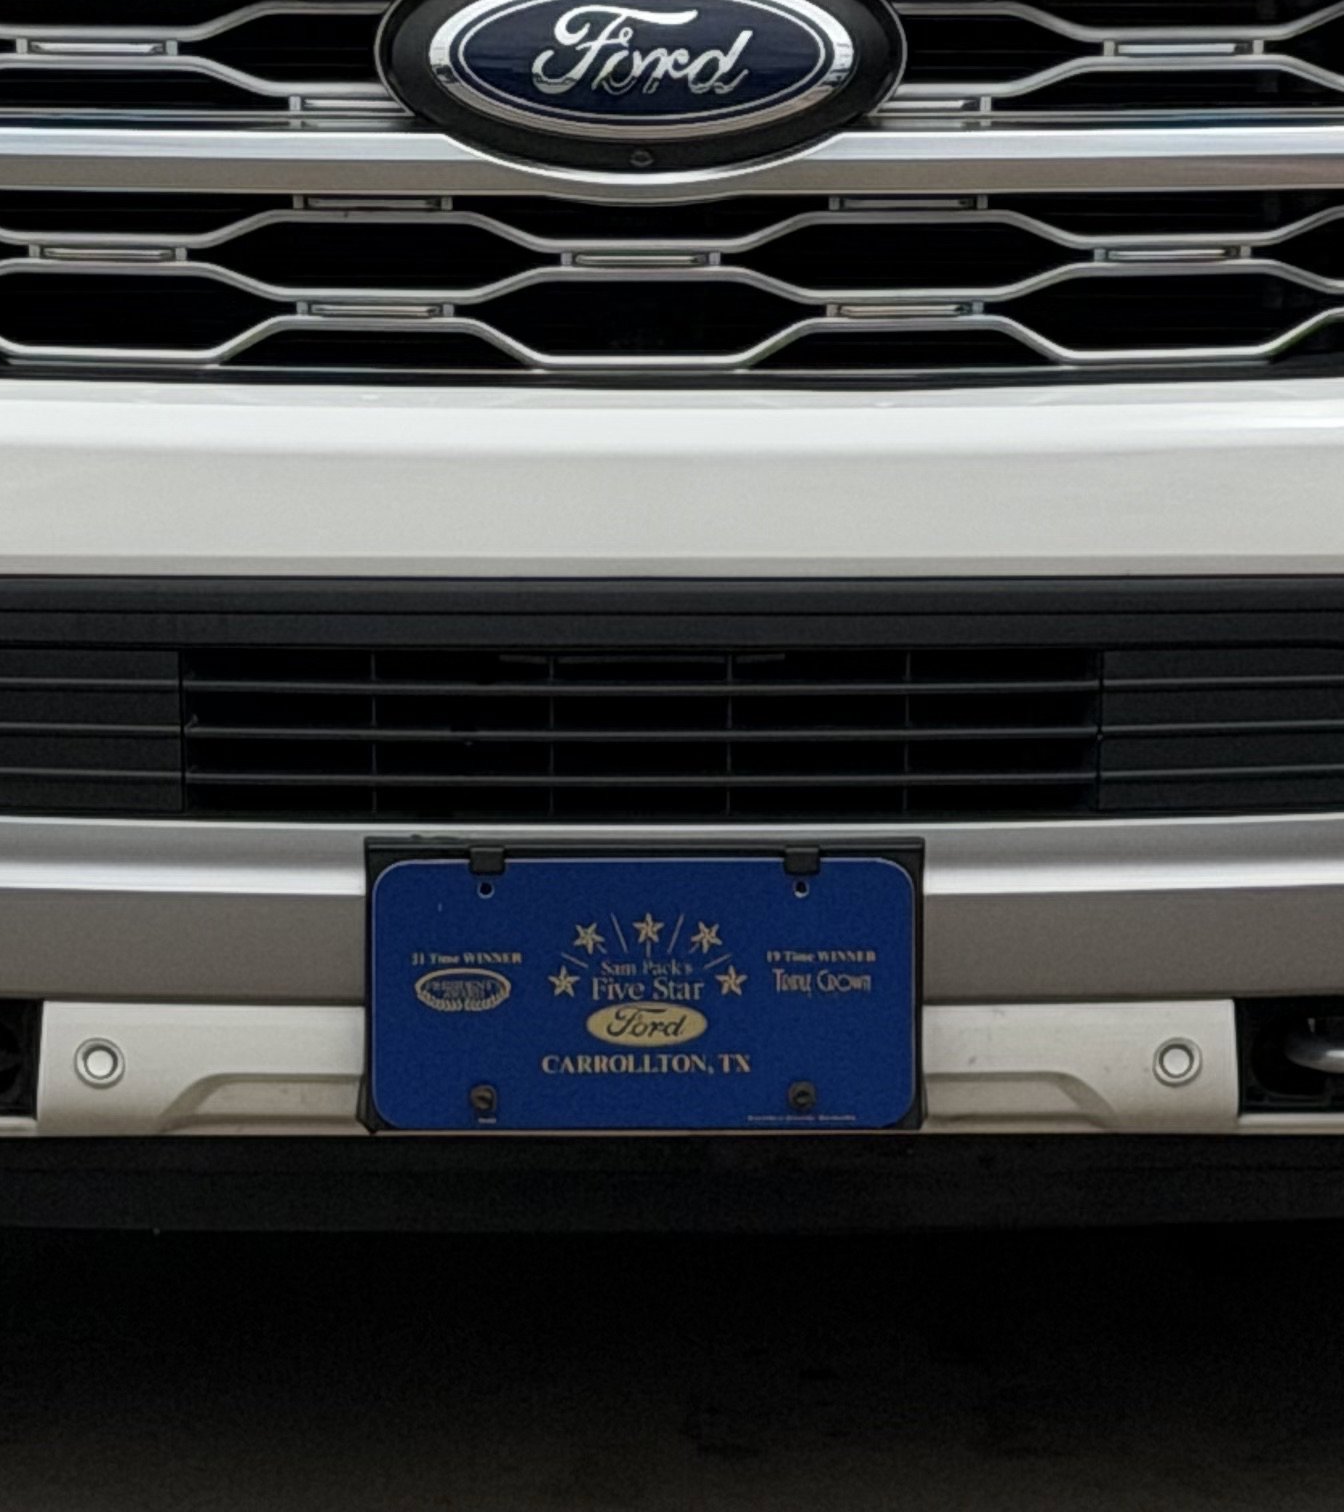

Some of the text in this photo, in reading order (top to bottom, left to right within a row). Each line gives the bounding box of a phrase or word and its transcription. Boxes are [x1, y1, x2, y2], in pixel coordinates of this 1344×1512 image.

[531, 3, 754, 95] Ford
[463, 951, 522, 965] WINNER
[817, 950, 876, 963] WINNER
[600, 961, 637, 977] Sam
[592, 975, 705, 1001] Five Star
[606, 1006, 688, 1039] Ford
[541, 1053, 752, 1075] CARROLLTON, TX
